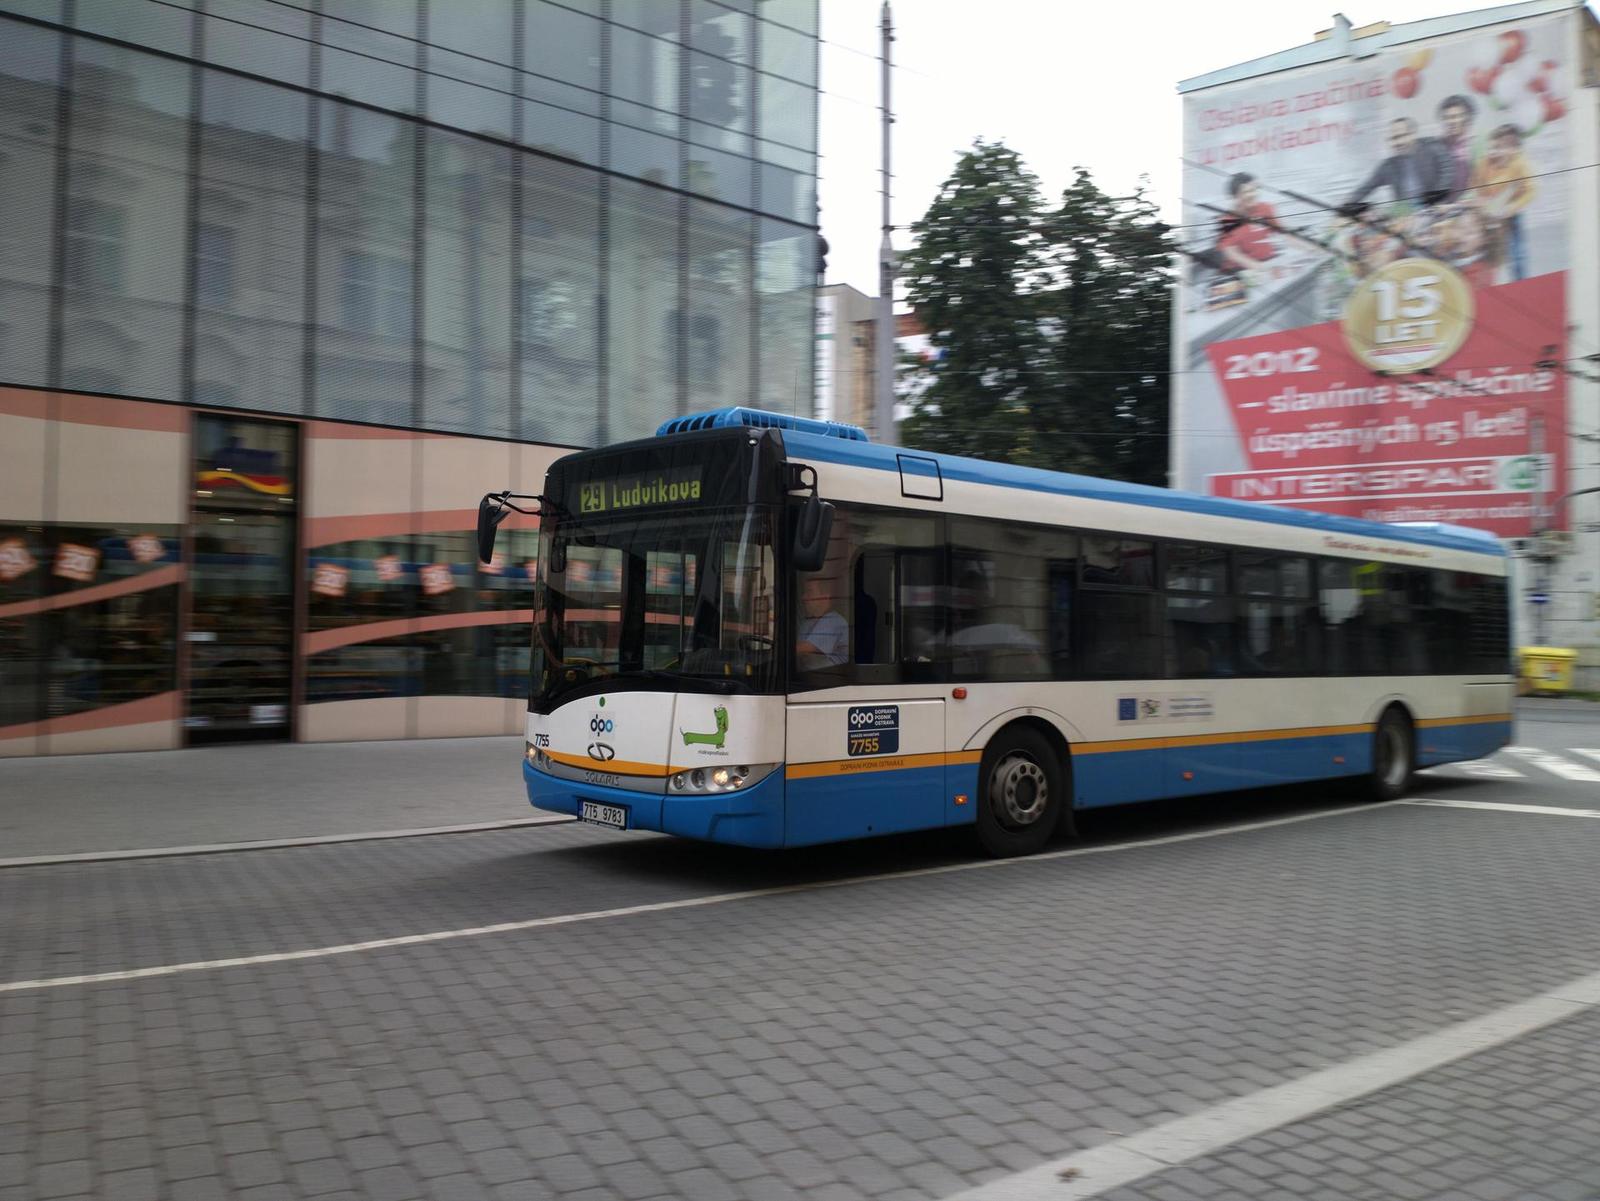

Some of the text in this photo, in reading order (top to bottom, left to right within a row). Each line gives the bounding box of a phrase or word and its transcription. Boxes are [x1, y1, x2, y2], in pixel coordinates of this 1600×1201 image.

[1370, 275, 1444, 321] 15
[1375, 319, 1442, 344] LET
[1224, 347, 1320, 380] 2012
[1267, 381, 1392, 414] slavíme
[1249, 416, 1420, 457] úspěšných
[1424, 419, 1461, 446] 15
[1232, 464, 1493, 498] INTERSPAR
[590, 714, 613, 737] dpo
[535, 733, 549, 747] 7755
[851, 738, 879, 754] 7755
[585, 771, 620, 786] SOLARIS
[584, 803, 622, 823] 7T5 9783
